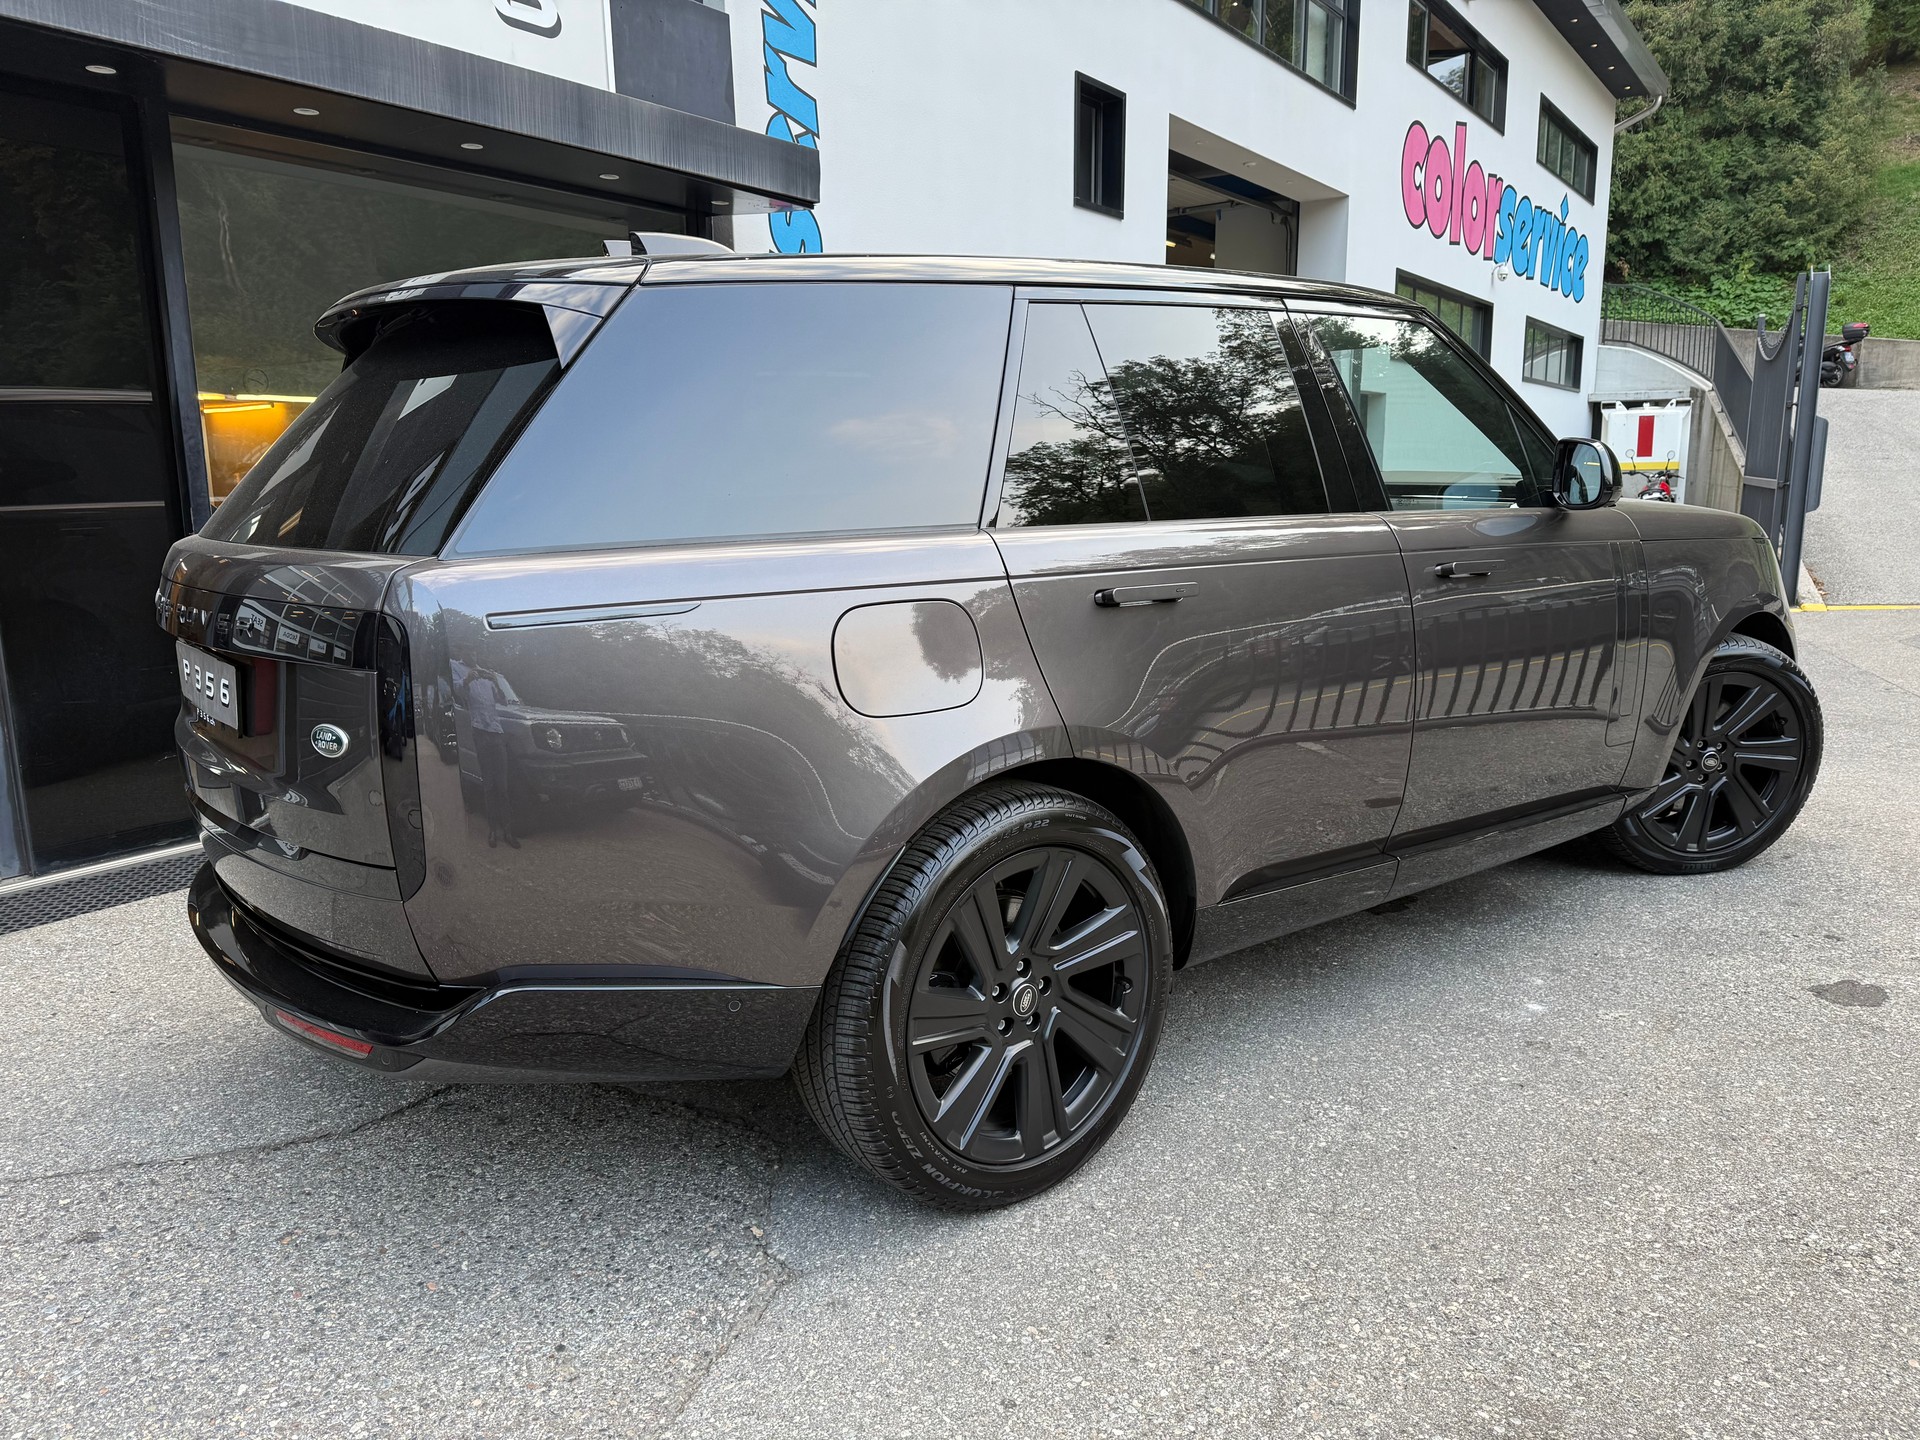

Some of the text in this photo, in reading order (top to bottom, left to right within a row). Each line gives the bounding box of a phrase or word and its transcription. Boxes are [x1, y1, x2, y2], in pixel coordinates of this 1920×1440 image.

[316, 730, 332, 742] LAND
[317, 740, 338, 752] ROVER
[920, 1161, 1006, 1200] SCORPION
